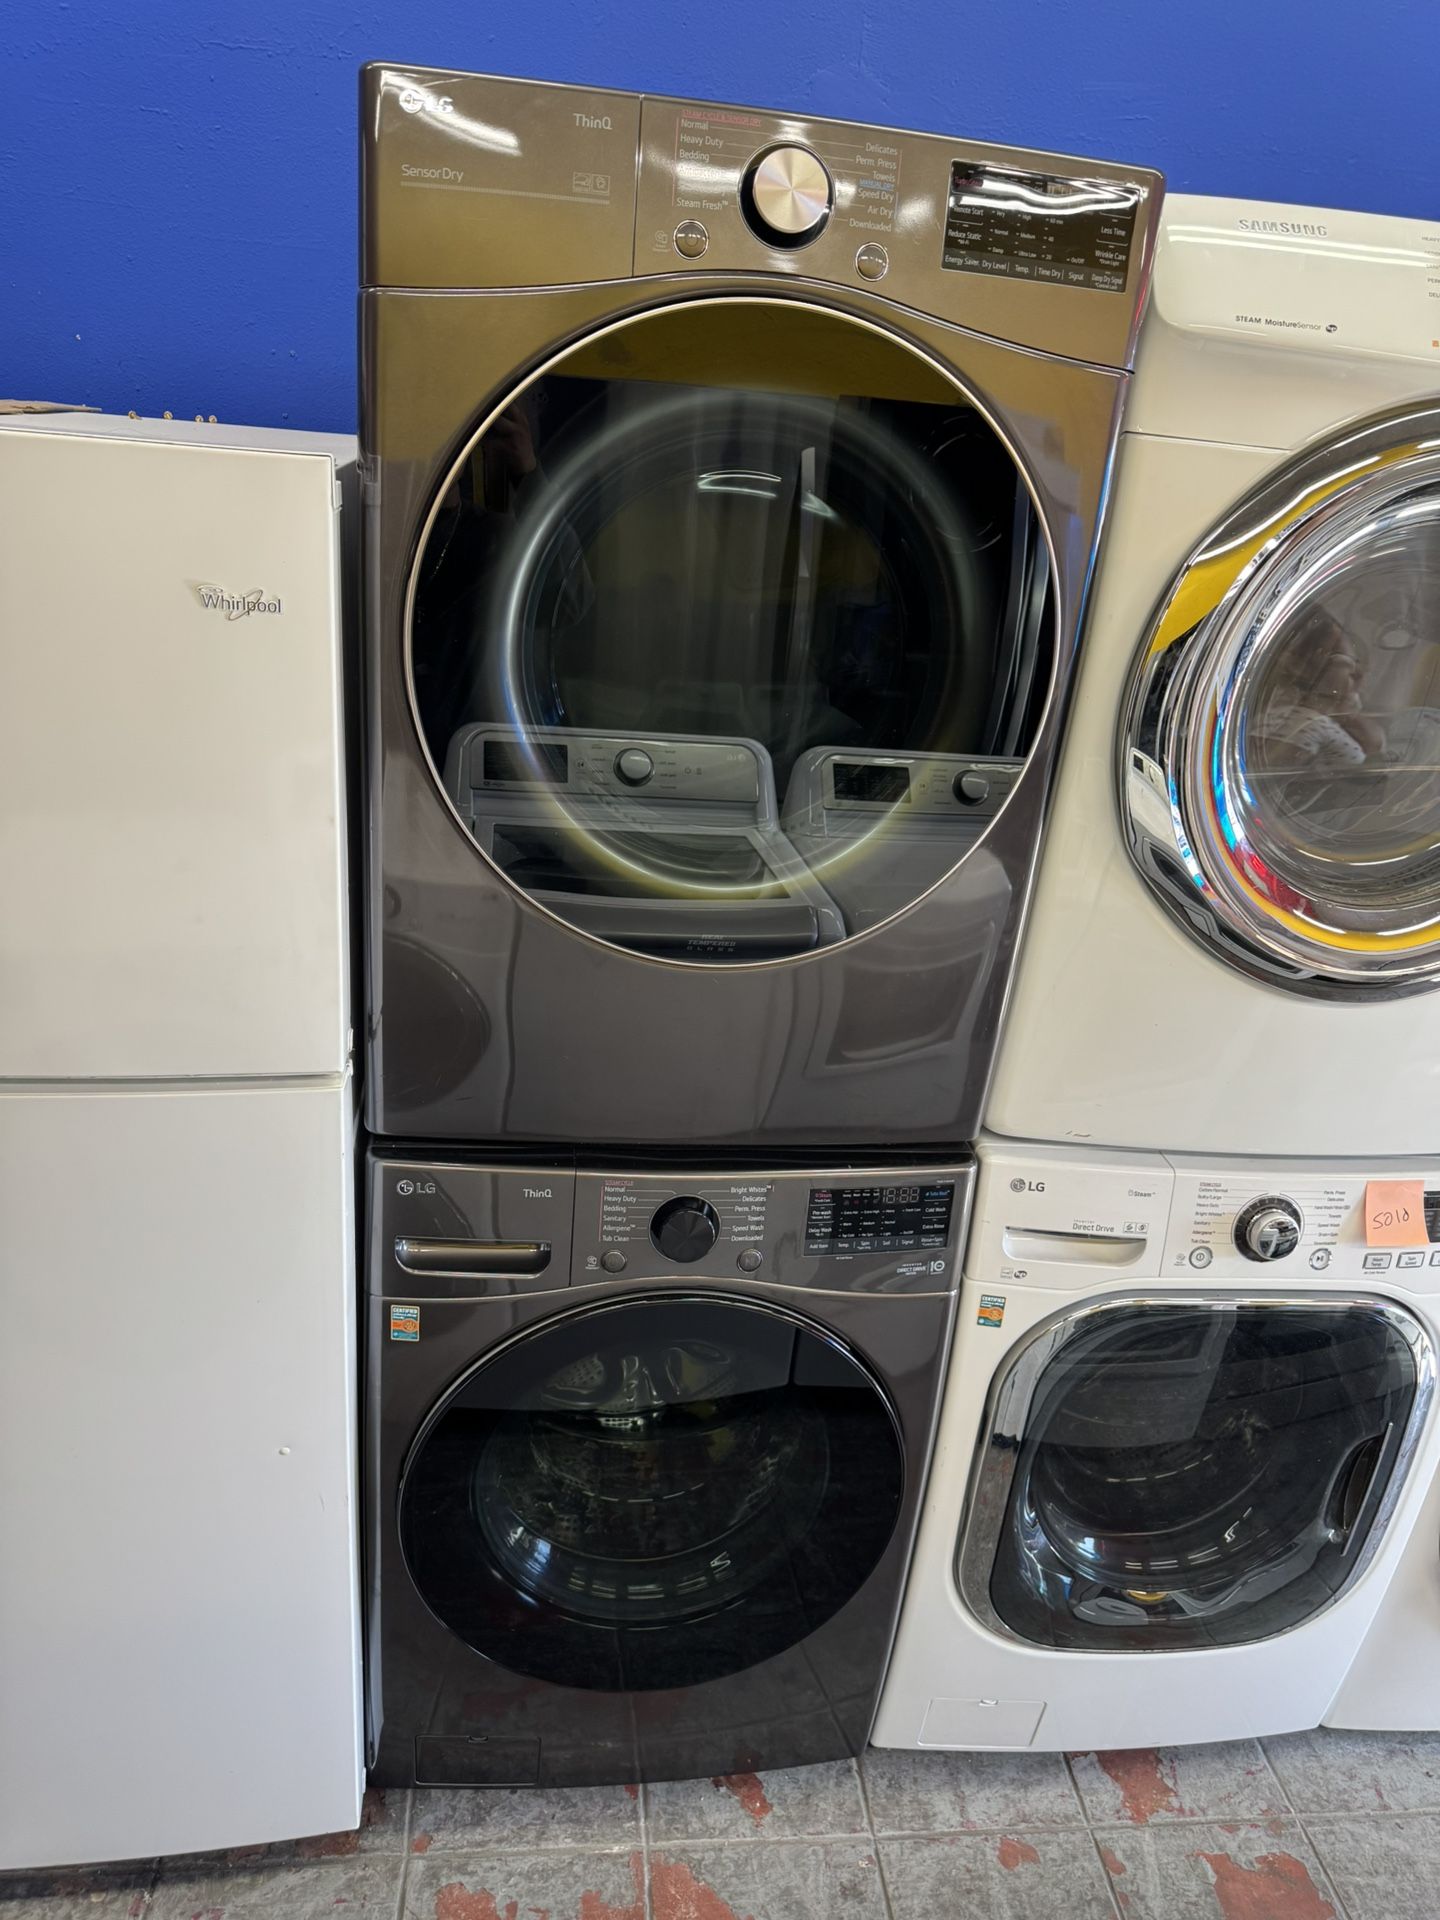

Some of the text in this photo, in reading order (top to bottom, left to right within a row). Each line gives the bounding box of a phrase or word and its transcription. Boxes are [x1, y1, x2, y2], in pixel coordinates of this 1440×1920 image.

[424, 95, 454, 113] LG
[573, 112, 612, 130] ThinQ
[681, 119, 709, 130] Normal
[680, 133, 724, 149] Heavy Duty
[865, 142, 898, 156] Delicates
[679, 149, 710, 163] Bedding
[877, 158, 897, 170] Press
[873, 170, 896, 182] Towels
[858, 188, 895, 204] Speed Dry
[677, 198, 701, 209] Steam
[867, 205, 893, 219] Air Dry
[971, 208, 984, 217] Start
[849, 217, 892, 232] Downloaded
[1239, 218, 1328, 237] SAMSUNG
[947, 229, 982, 241] Reduce Static
[1101, 226, 1126, 237] Less Time
[945, 255, 964, 266] Energy
[1095, 250, 1127, 261] Wrinkle Care
[982, 260, 1007, 270] Dry Level
[1038, 267, 1061, 279] Time Dry
[1068, 271, 1085, 281] Signal
[1235, 314, 1322, 331] STEAM MoistureSensor
[200, 590, 281, 620] Whirlpool
[416, 1182, 436, 1194] LG
[731, 1187, 747, 1195] Bright
[1028, 1181, 1046, 1192] LG
[523, 1188, 552, 1198] ThinQ
[604, 1195, 637, 1204] Heavy Duty
[603, 1205, 627, 1213] Bedding
[603, 1215, 626, 1223] Sanitary
[1072, 1222, 1115, 1233] Direct Drive
[731, 1234, 763, 1242] Downloaded
